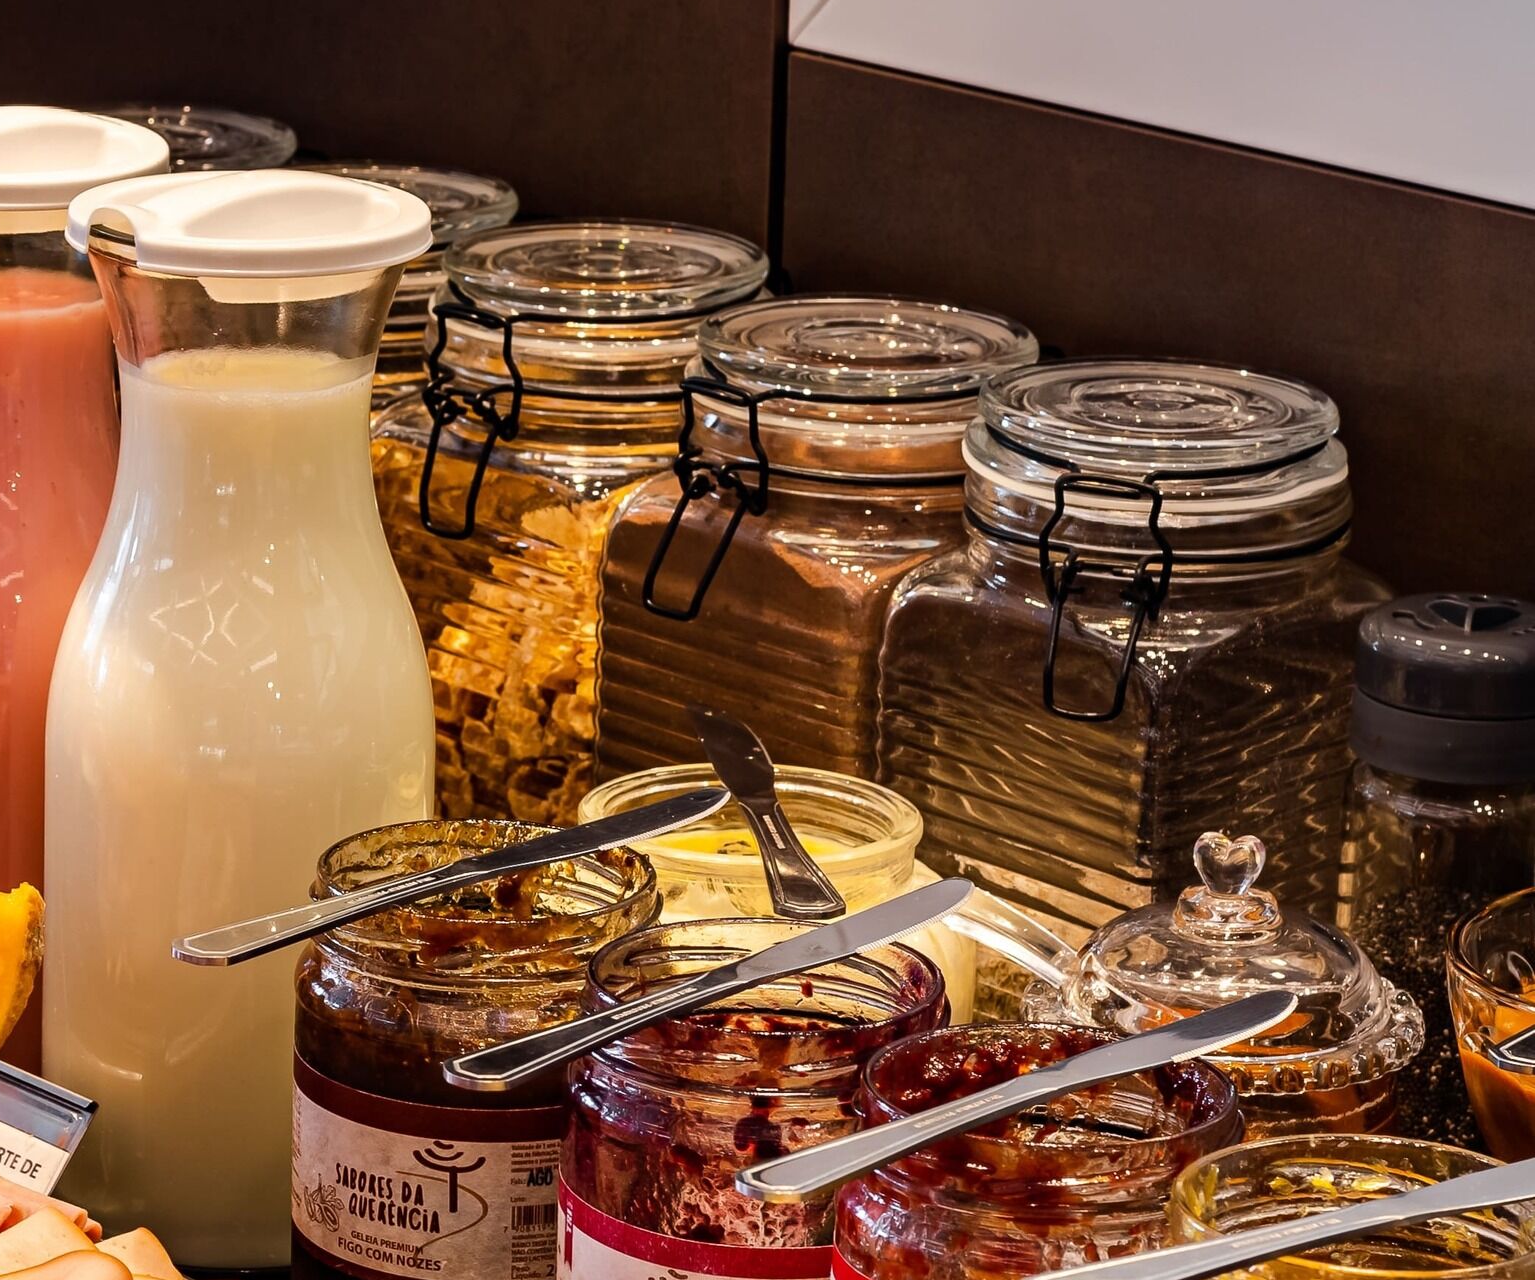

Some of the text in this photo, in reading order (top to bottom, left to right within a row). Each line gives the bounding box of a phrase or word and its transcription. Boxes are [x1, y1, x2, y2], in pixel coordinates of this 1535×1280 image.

[19, 1159, 42, 1179] DE
[335, 1162, 424, 1206] SABORES DA
[338, 1237, 441, 1271] FIGO COM NOZES
[351, 1230, 423, 1255] GELEIA PREMIUM
